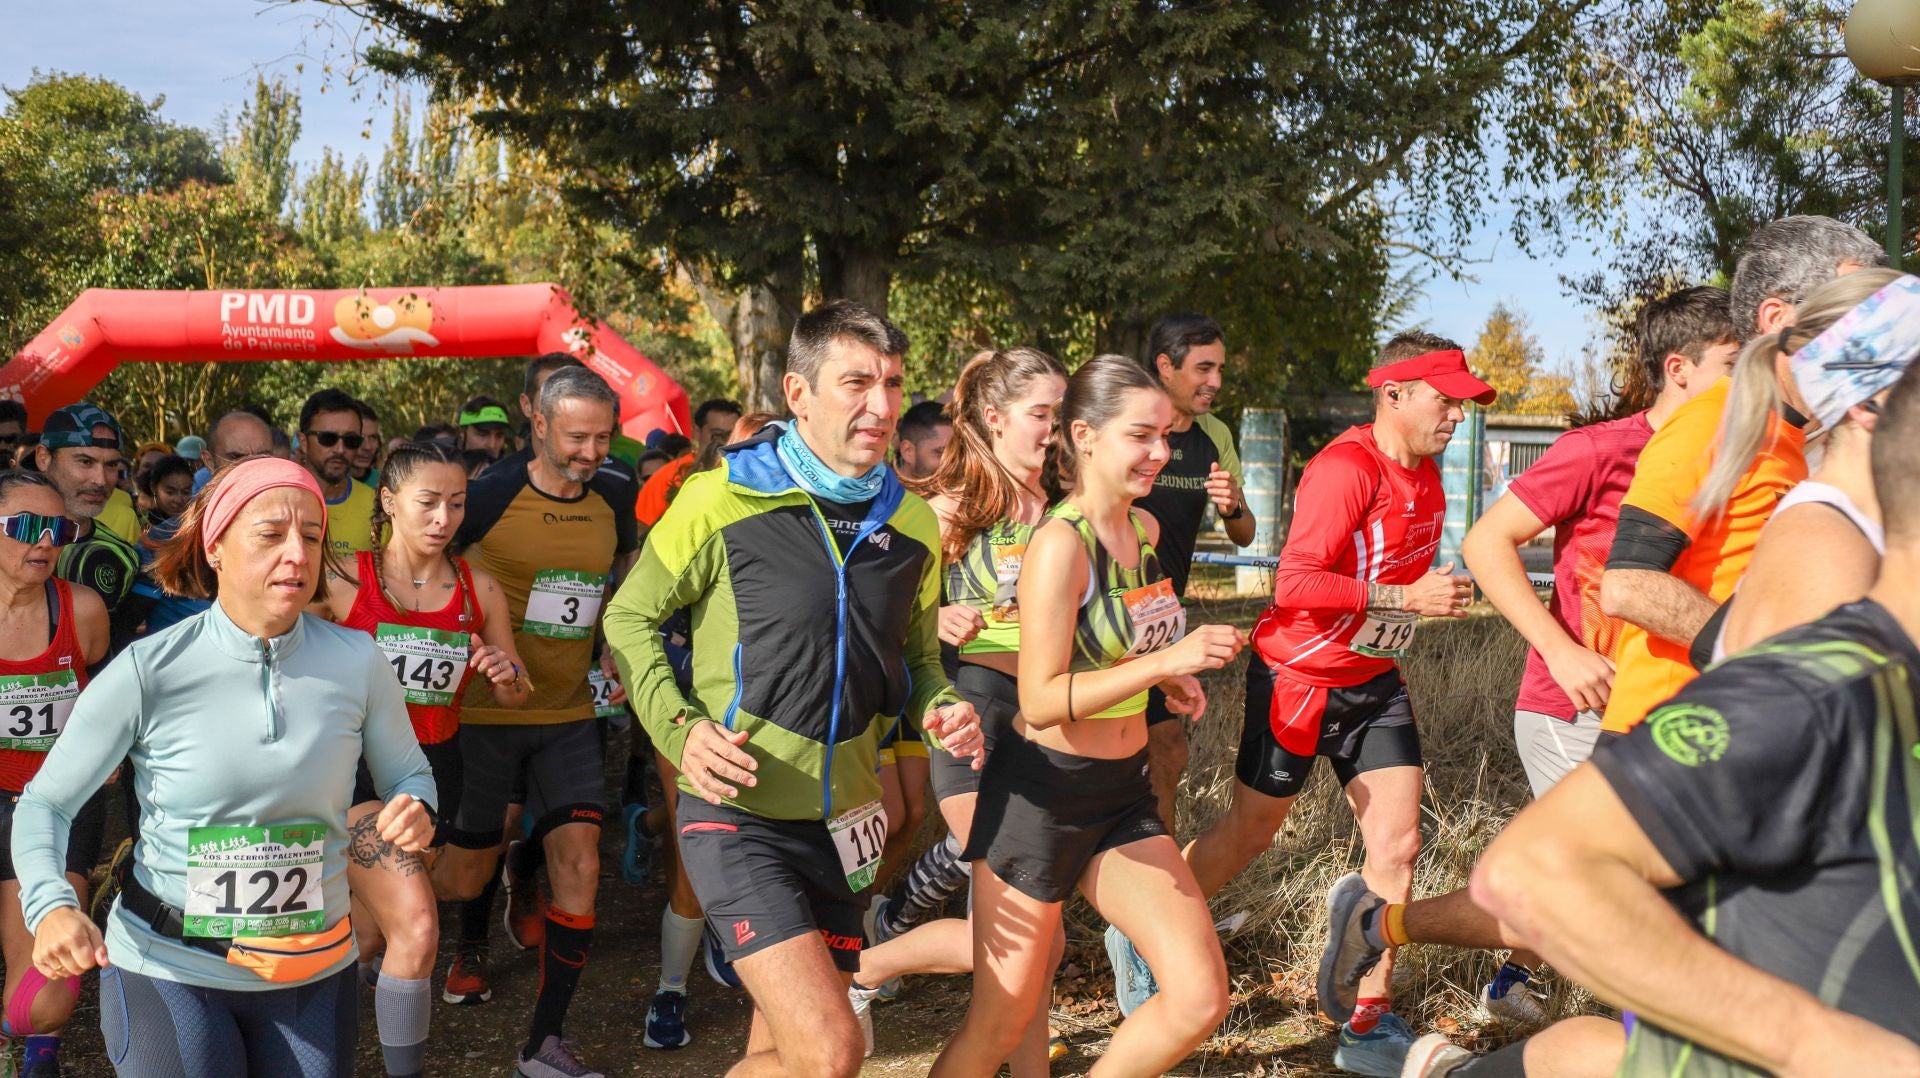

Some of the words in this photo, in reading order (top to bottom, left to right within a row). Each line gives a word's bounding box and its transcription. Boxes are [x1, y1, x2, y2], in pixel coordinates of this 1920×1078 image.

[220, 292, 316, 326] PMD
[221, 322, 316, 341] Ayuntamiento
[223, 336, 243, 350] de
[247, 337, 317, 353] Palencia
[560, 514, 593, 522] LURBEL
[988, 536, 1016, 545] 42K
[560, 596, 580, 625] 3
[1135, 615, 1179, 655] 324
[1366, 622, 1412, 650] 119
[405, 643, 430, 652] CERROS
[431, 647, 465, 657] PALENTINOS
[390, 654, 455, 690] 143
[40, 687, 78, 698] PALENTINOS
[8, 702, 58, 737] 31
[272, 849, 320, 861] PALENTINOS
[850, 814, 886, 868] 110
[214, 866, 308, 915] 122
